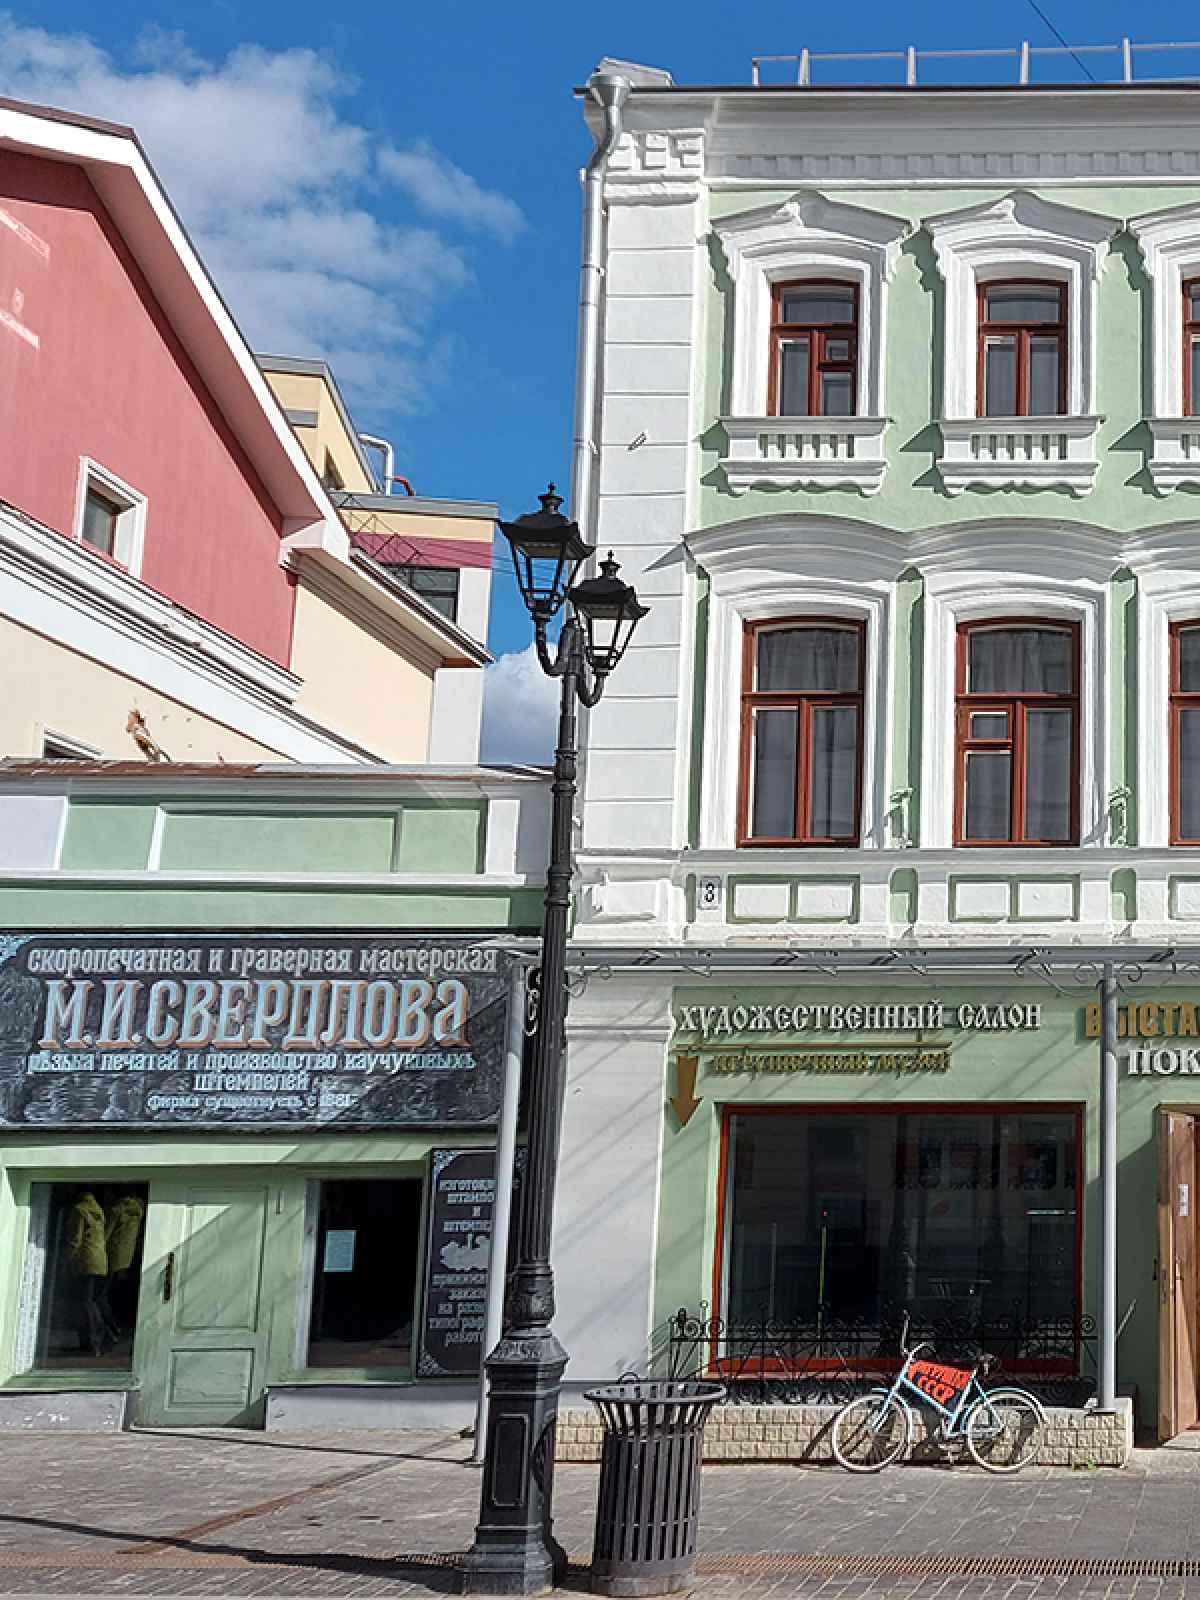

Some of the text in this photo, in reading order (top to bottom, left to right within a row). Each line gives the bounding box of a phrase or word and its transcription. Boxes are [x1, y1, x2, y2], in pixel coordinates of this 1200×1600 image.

[704, 882, 715, 903] 8
[27, 948, 497, 979] скоропечатная и граверная мастерская
[679, 999, 1042, 1036] ХУДОЖЕСТВЕННЫЙ САЛОН
[101, 1051, 180, 1071] печатей
[187, 1054, 199, 1070] и
[205, 1054, 337, 1072] производство
